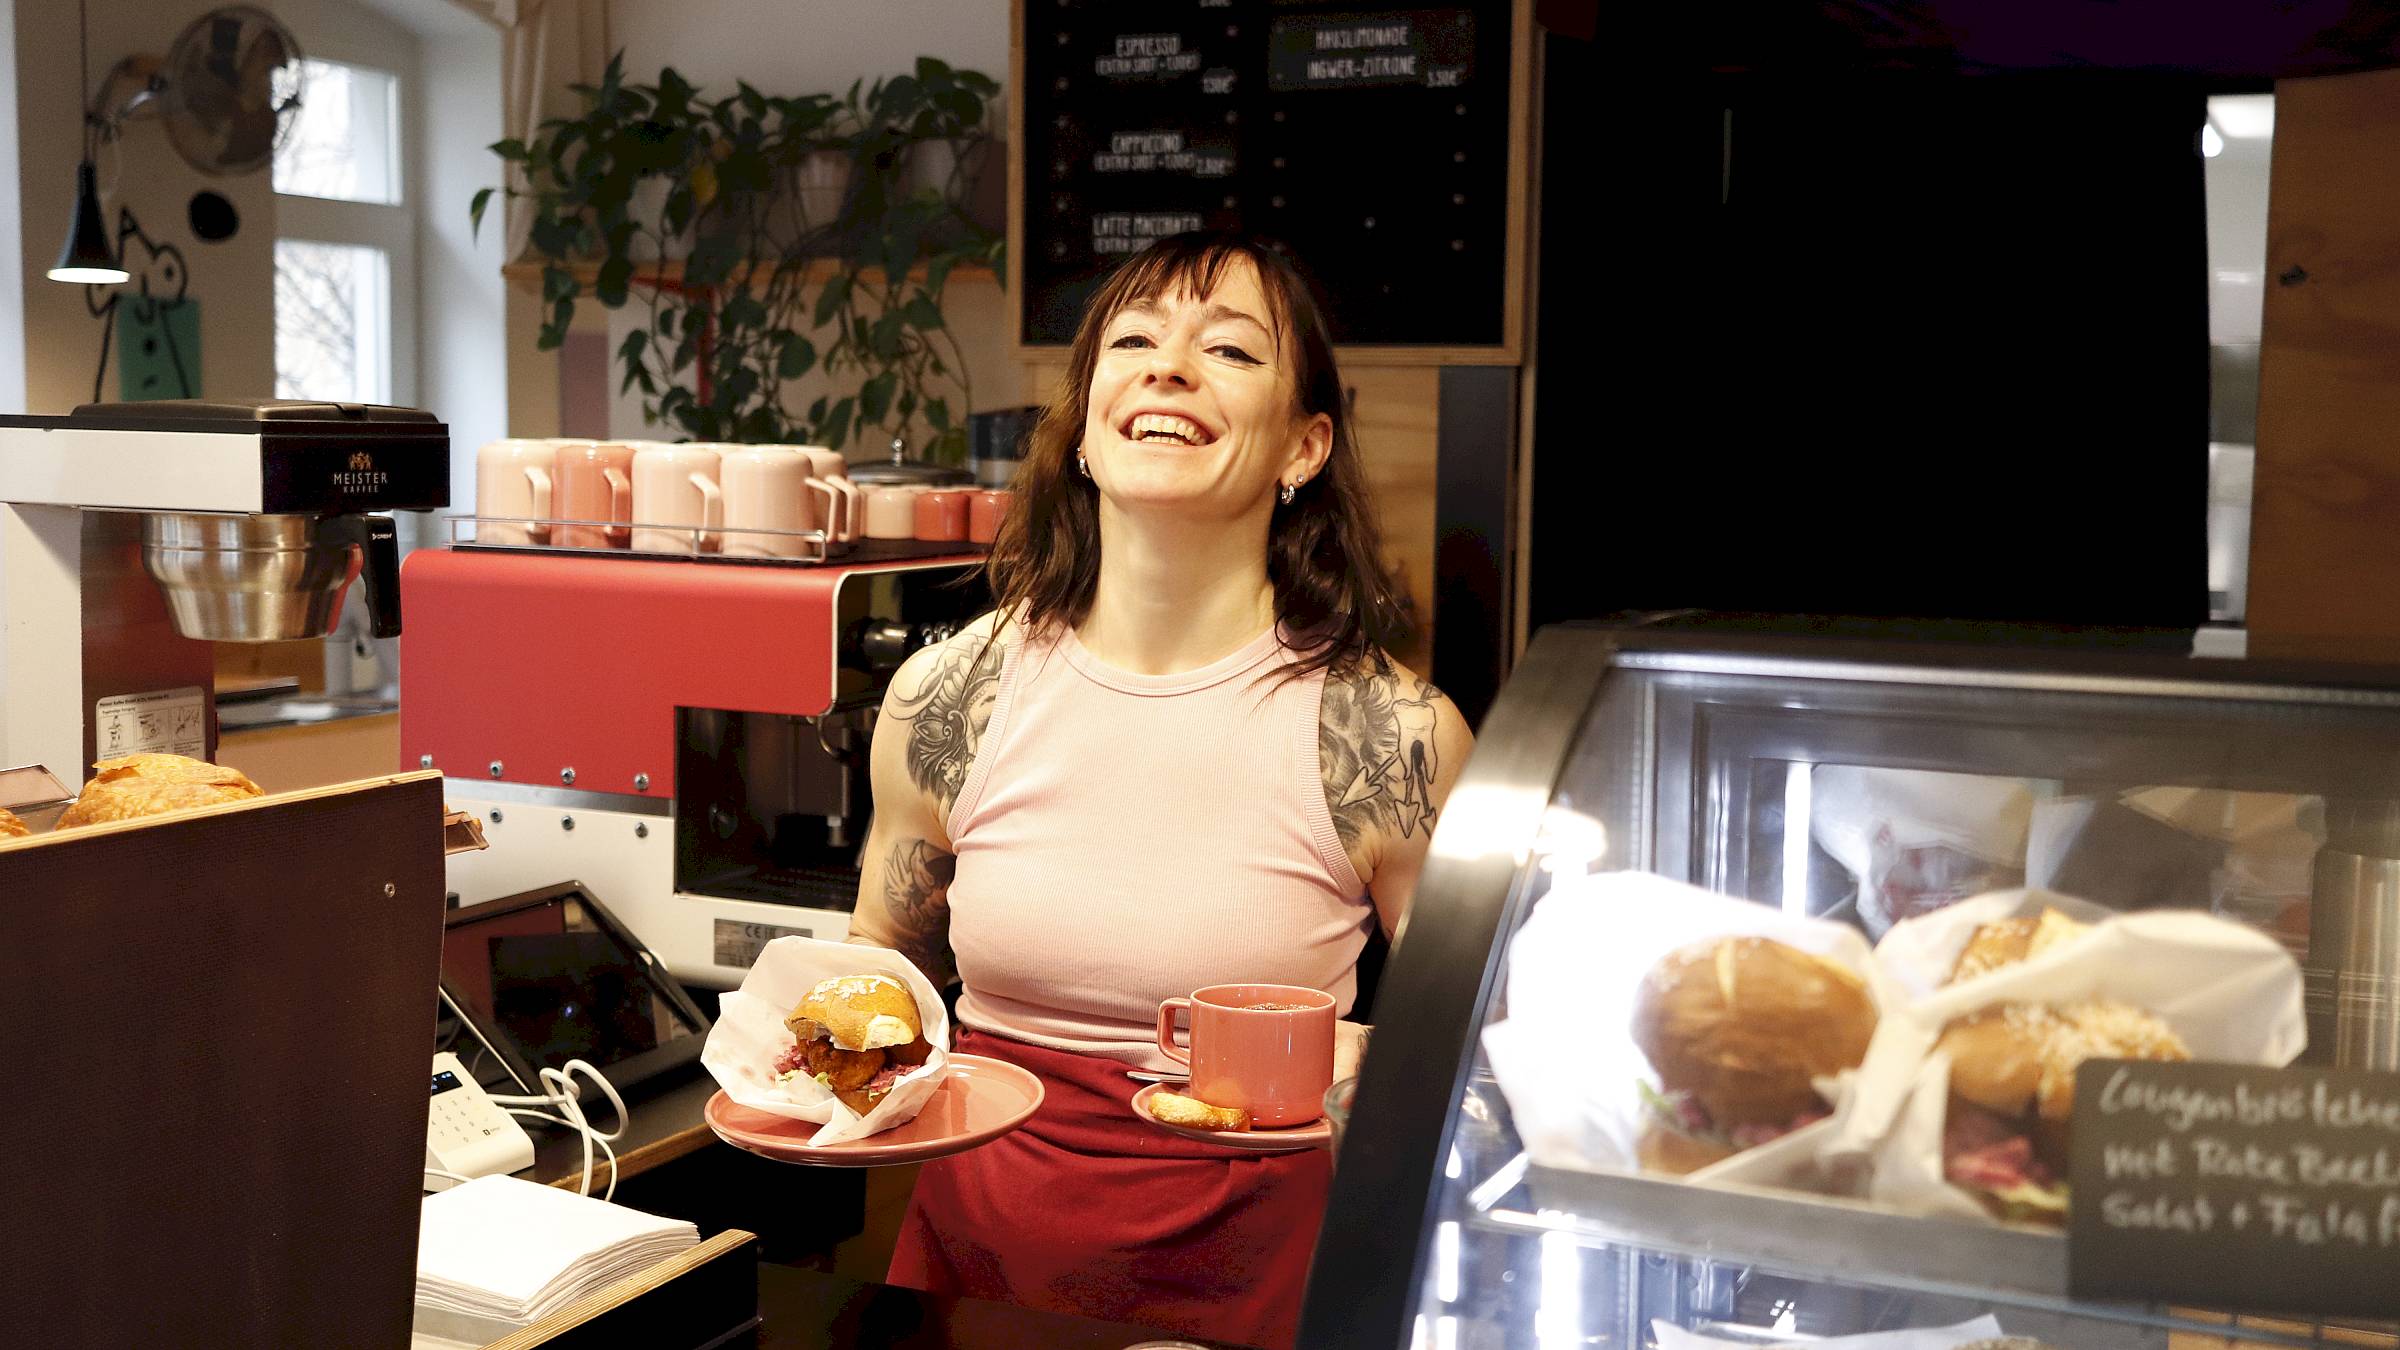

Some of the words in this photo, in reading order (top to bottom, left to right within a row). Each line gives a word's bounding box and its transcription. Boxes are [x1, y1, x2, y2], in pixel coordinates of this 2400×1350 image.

[1115, 37, 1180, 57] ESPRESSO
[1315, 26, 1408, 49] HAUSLIMONADE
[1307, 56, 1416, 80] INGWER-ZITRONE
[1112, 134, 1182, 153] CAPPUCCINO
[1093, 217, 1130, 236] LATTE
[333, 472, 388, 485] MEISTER
[343, 485, 380, 494] KAFFEE
[2102, 1192, 2214, 1231] Salat
